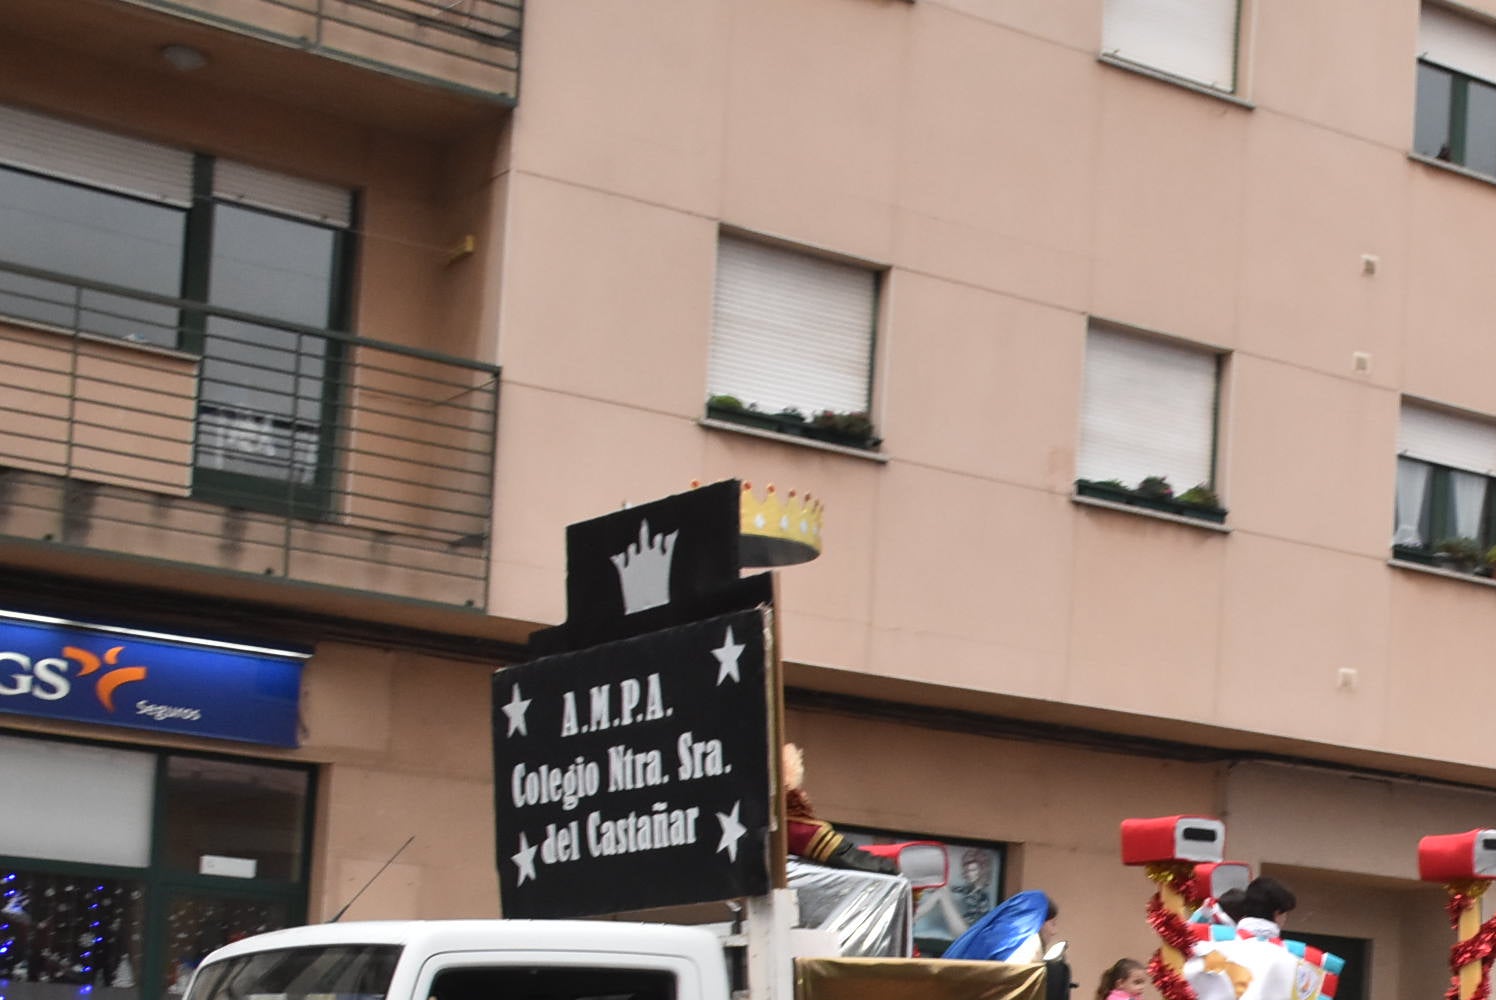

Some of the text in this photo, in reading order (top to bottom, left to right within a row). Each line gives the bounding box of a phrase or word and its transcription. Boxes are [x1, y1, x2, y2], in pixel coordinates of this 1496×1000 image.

[136, 699, 201, 721] Seguros
[561, 672, 674, 737] A.M.P.A.
[511, 731, 732, 811] Colegio Ntra. Sra.
[540, 801, 700, 865] del Castañar
